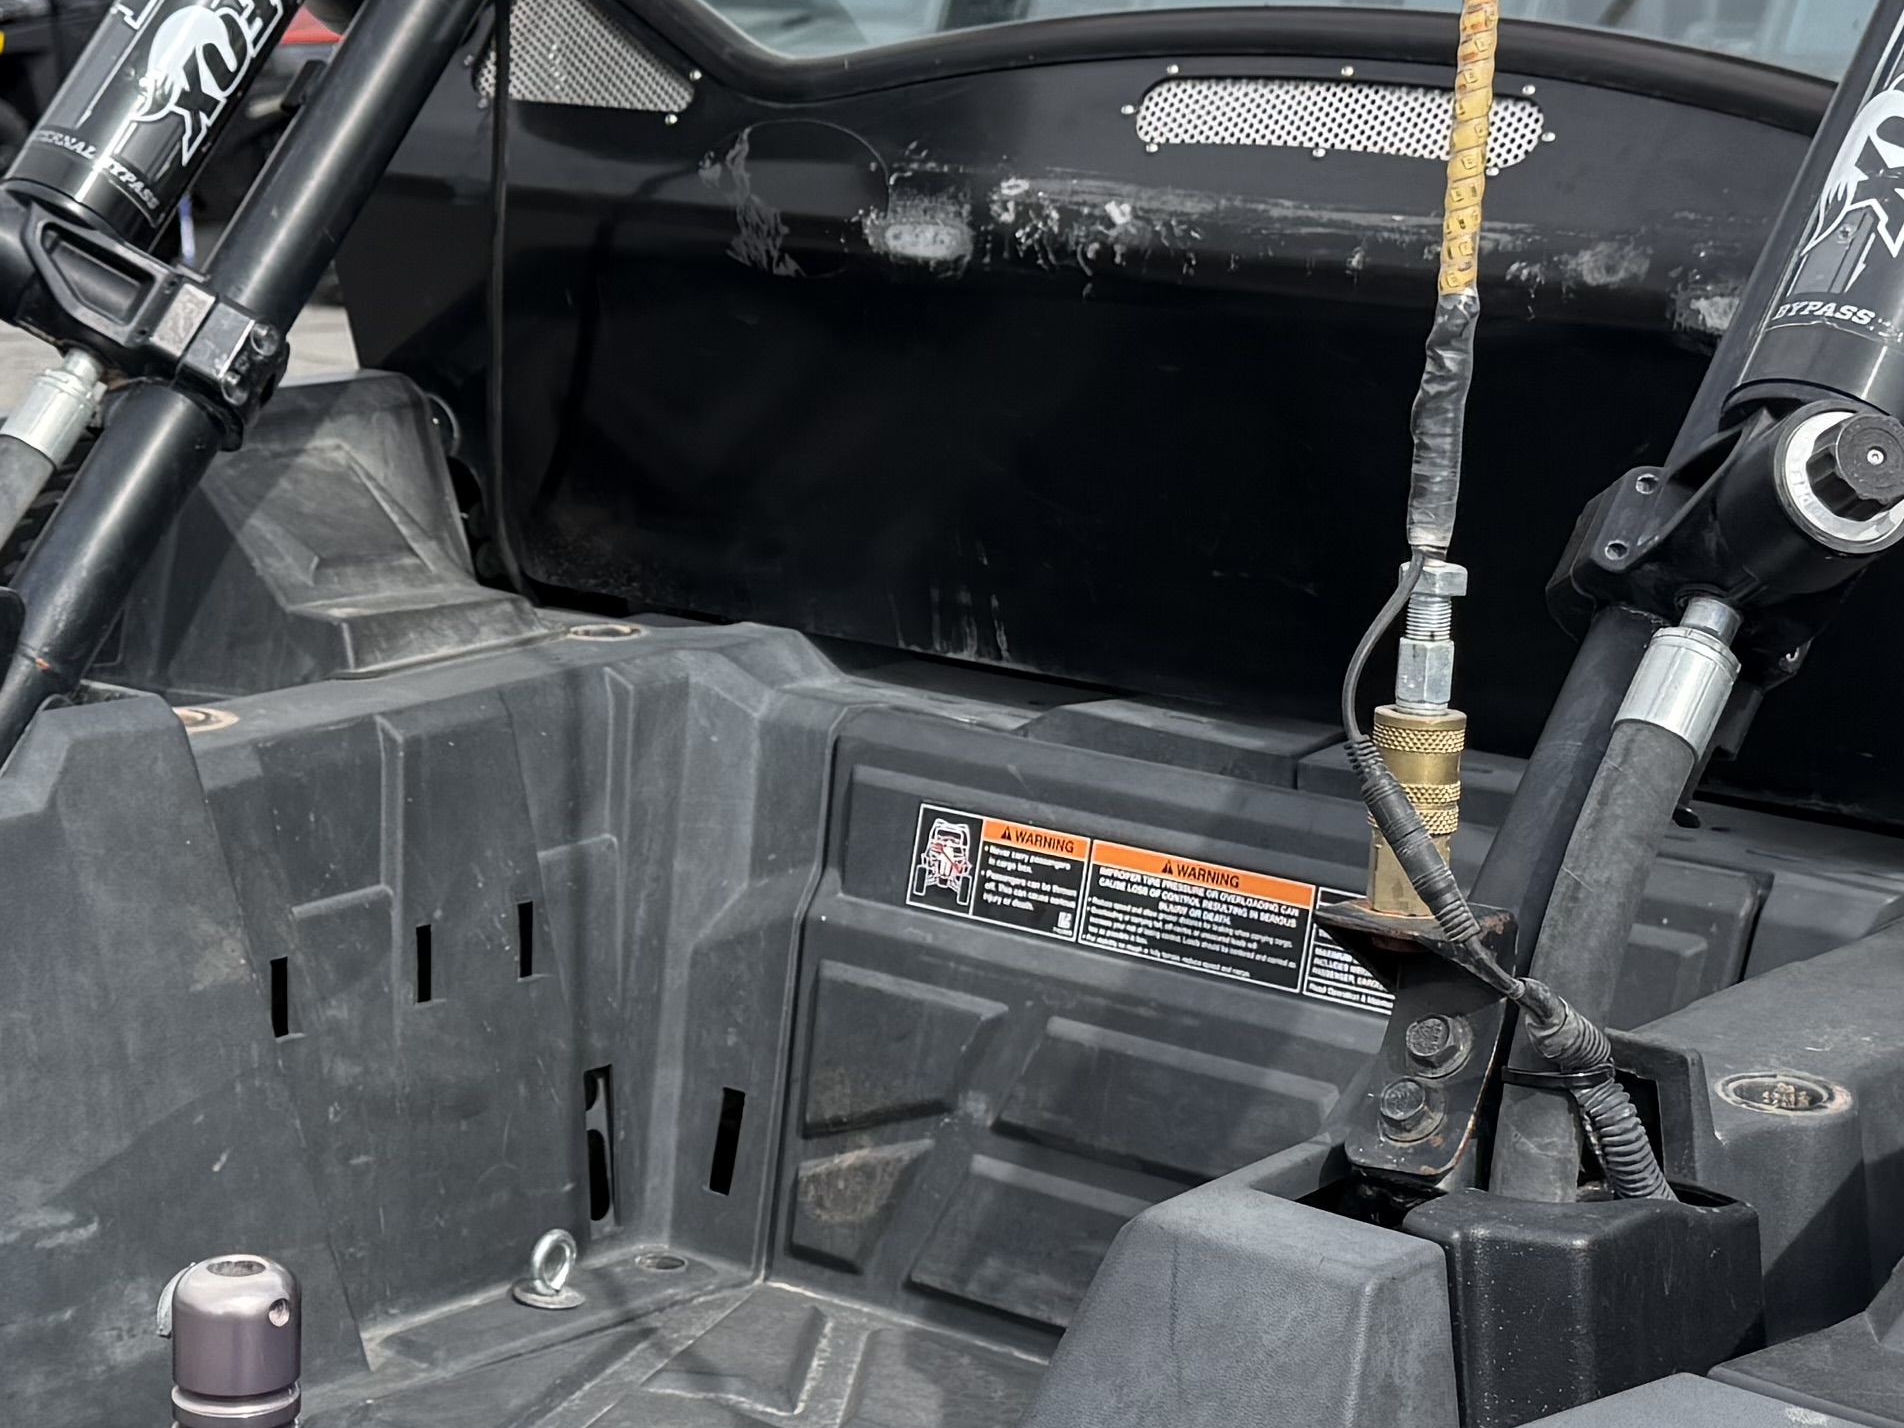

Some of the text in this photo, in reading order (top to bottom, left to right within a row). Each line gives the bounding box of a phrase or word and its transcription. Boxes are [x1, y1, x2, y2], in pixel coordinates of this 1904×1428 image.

[1774, 299, 1876, 326] BYPASS
[1014, 828, 1075, 854] WARNING
[1176, 863, 1240, 889] WARNING
